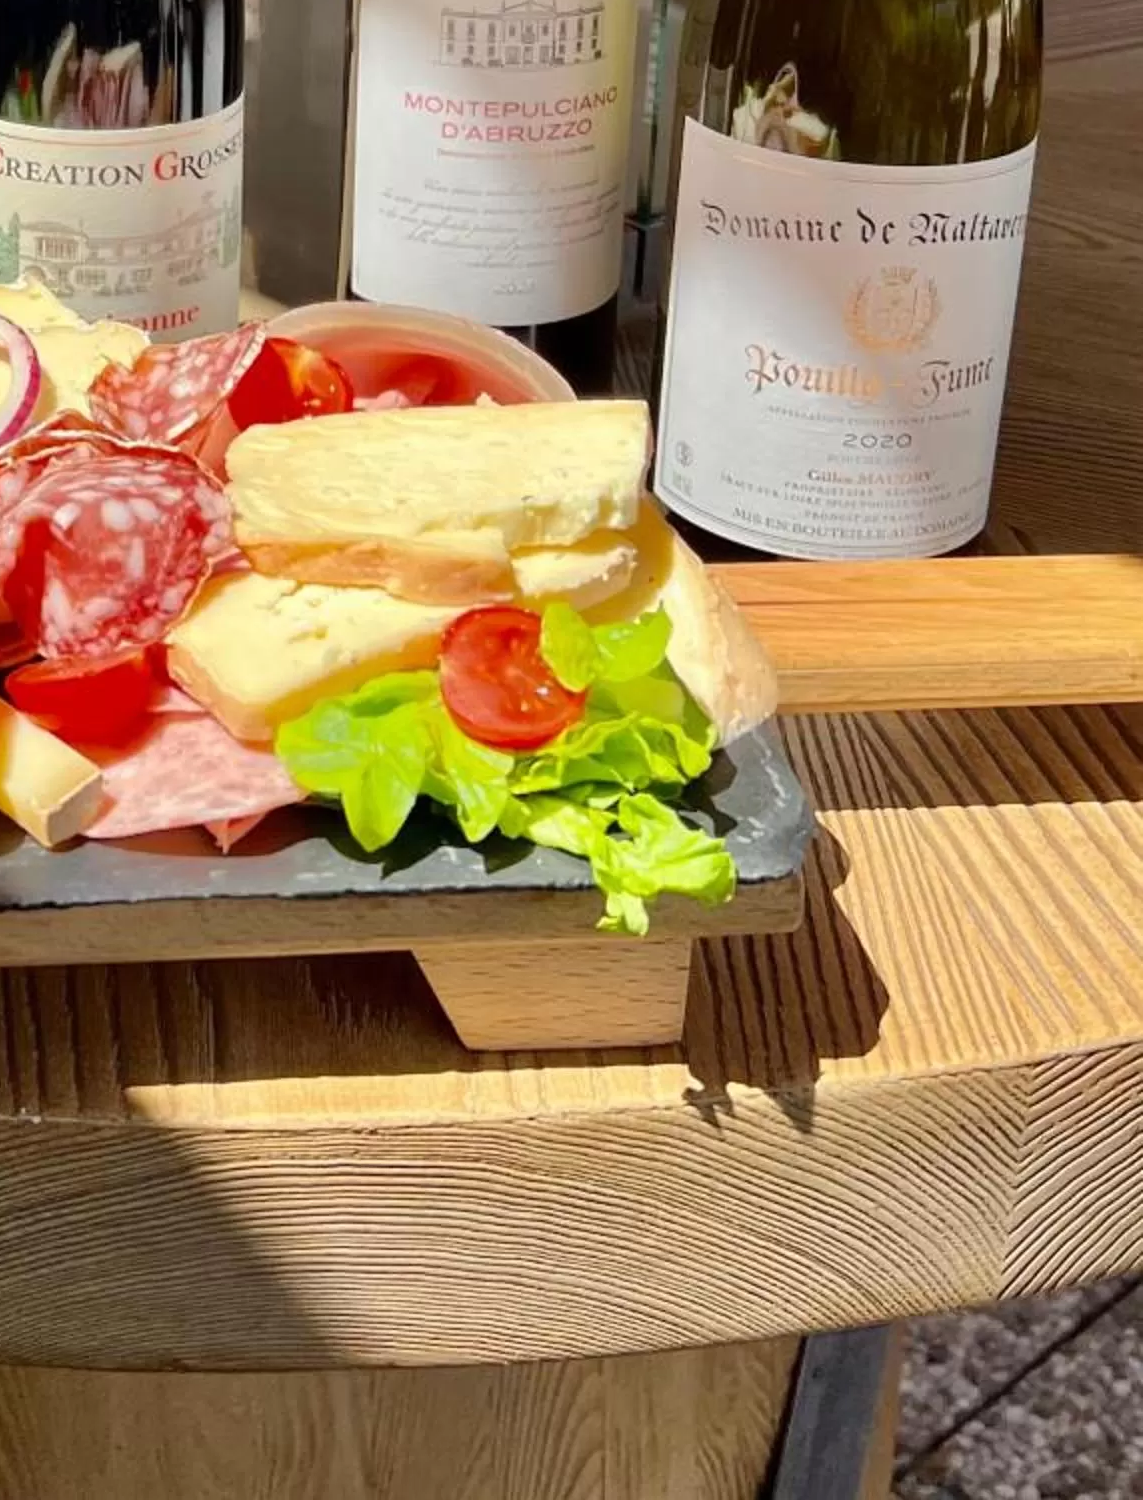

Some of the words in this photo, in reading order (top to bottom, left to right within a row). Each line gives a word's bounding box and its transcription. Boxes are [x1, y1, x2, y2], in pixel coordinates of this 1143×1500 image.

[404, 86, 618, 119] MONTEPULCIANO
[441, 118, 593, 142] D'ABRUZZO
[701, 203, 842, 243] Domaine
[857, 208, 895, 245] de
[843, 433, 912, 449] 2020
